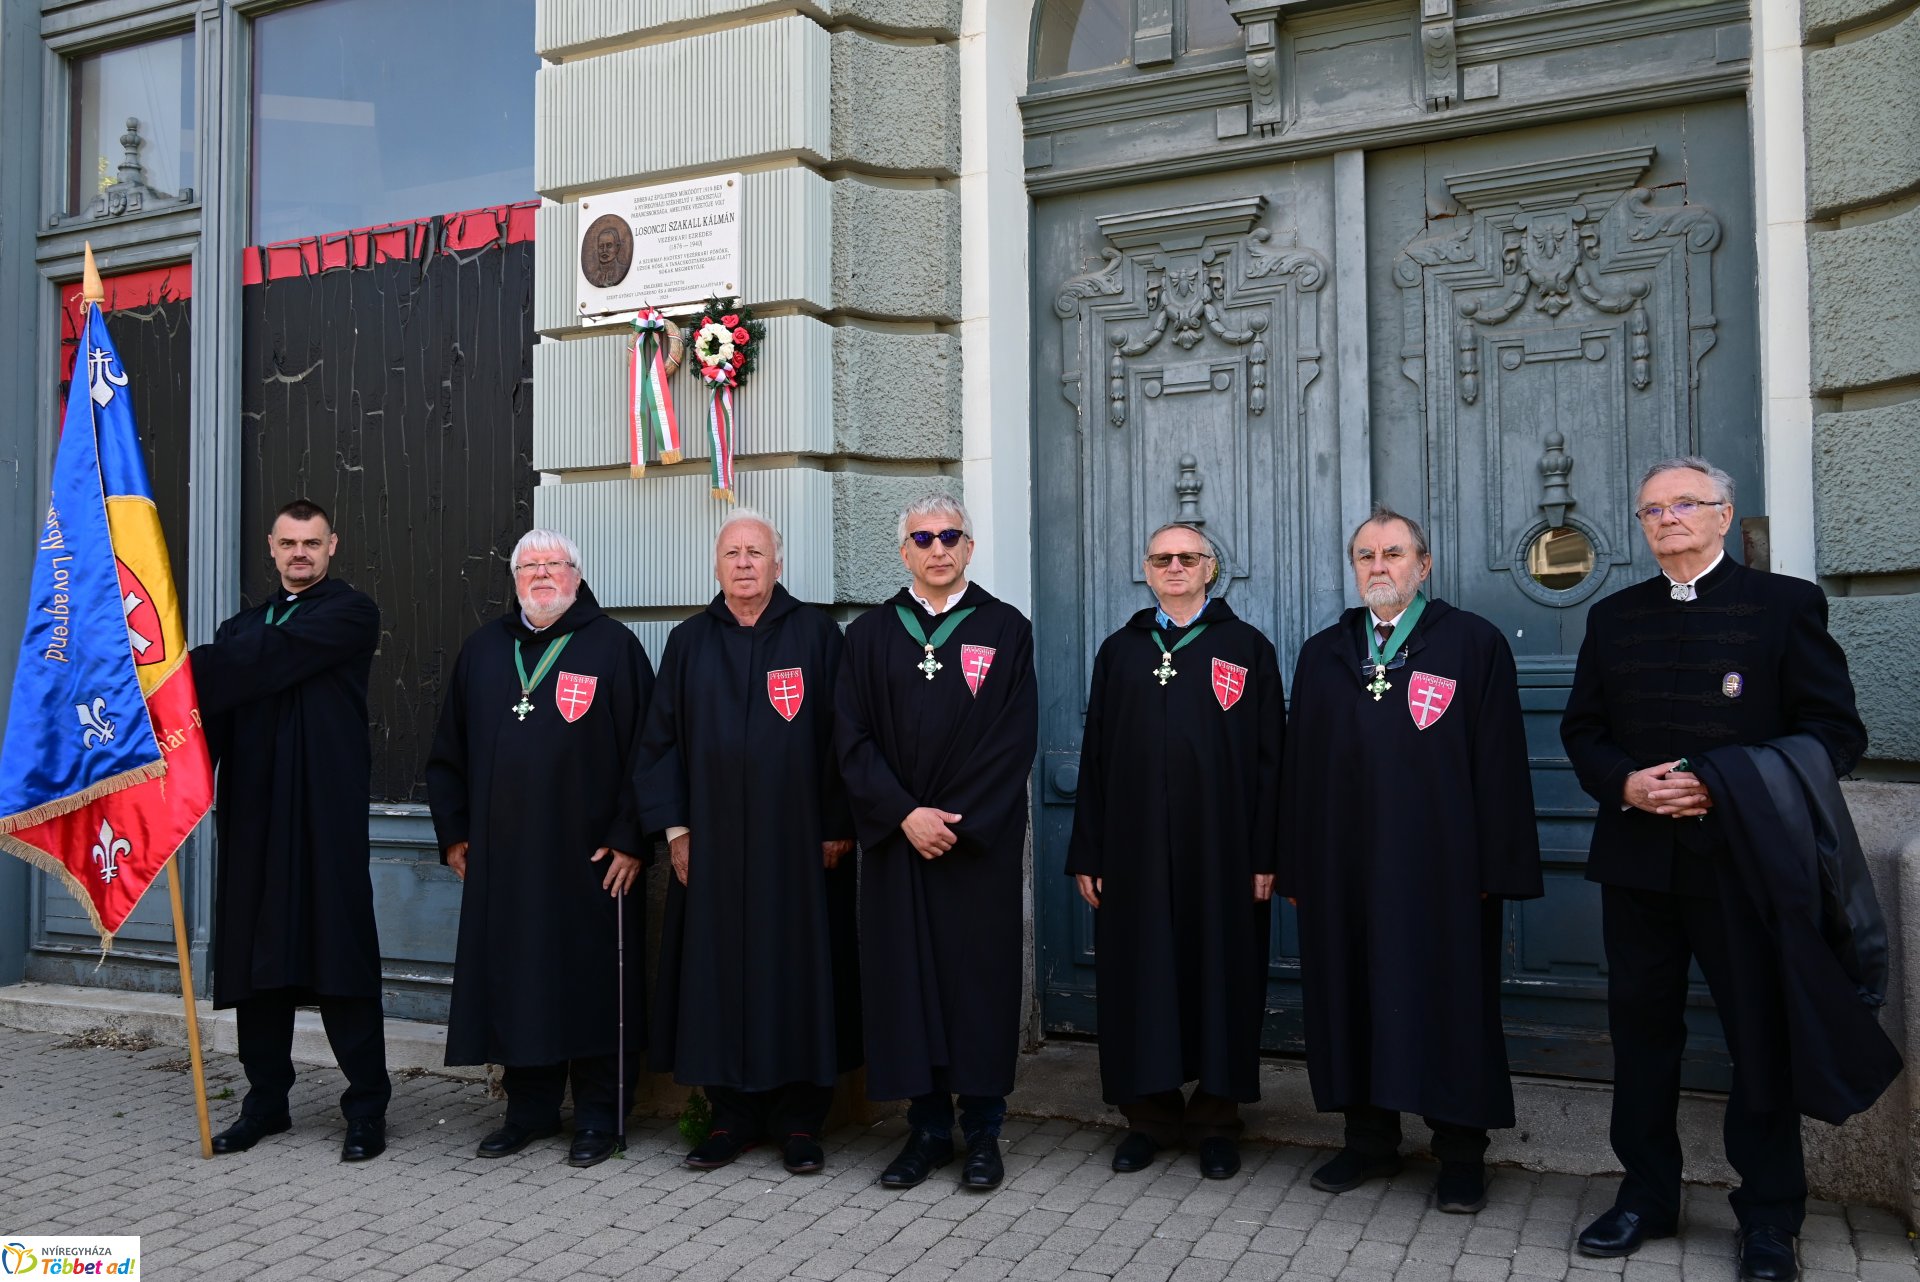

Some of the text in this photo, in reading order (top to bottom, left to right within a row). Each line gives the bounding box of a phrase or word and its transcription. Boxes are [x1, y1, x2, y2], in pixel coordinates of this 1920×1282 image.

[635, 212, 735, 236] LOSONCZI SZAKALL KÁLMÁN
[658, 231, 712, 243] VEZÉRKARI EZREDES
[45, 556, 72, 663] Lovagrend
